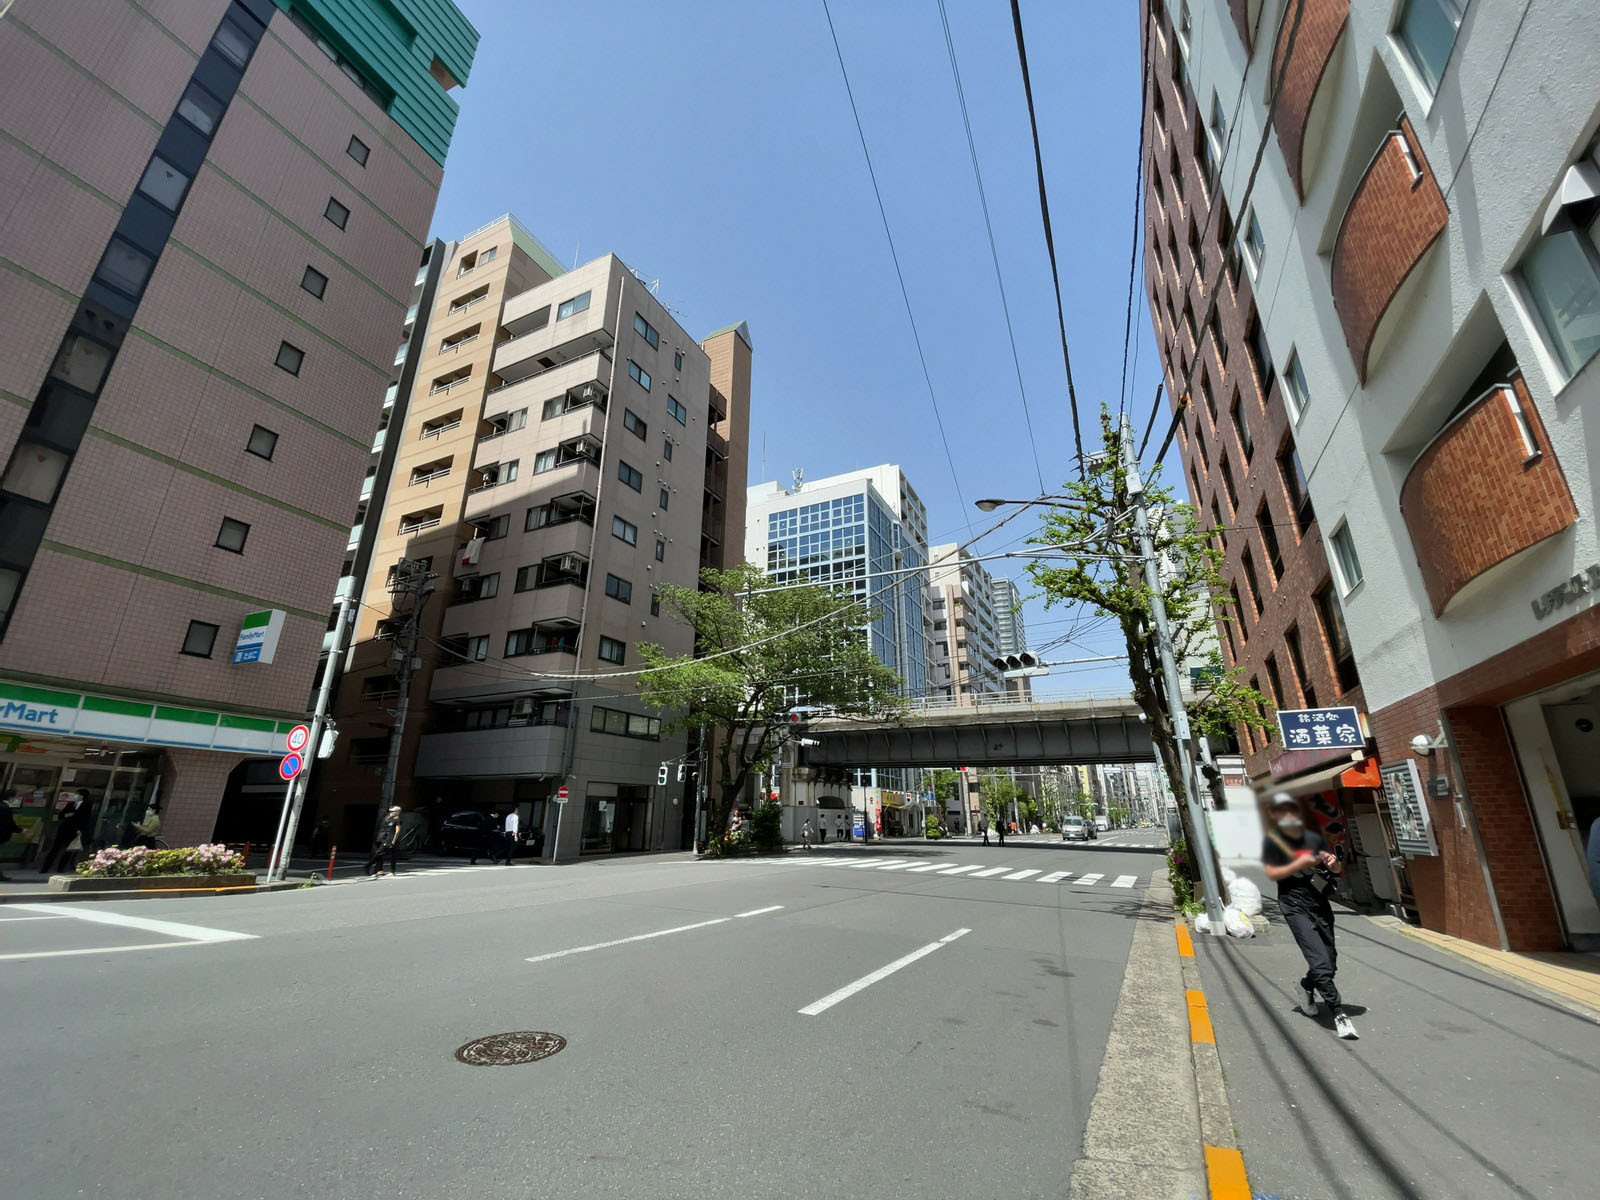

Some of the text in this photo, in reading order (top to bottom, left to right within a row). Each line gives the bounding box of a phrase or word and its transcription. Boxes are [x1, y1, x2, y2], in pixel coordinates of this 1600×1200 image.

[1297, 712, 1340, 723] 銘酒処
[291, 732, 304, 745] 40
[1289, 723, 1357, 745] 酒菜家
